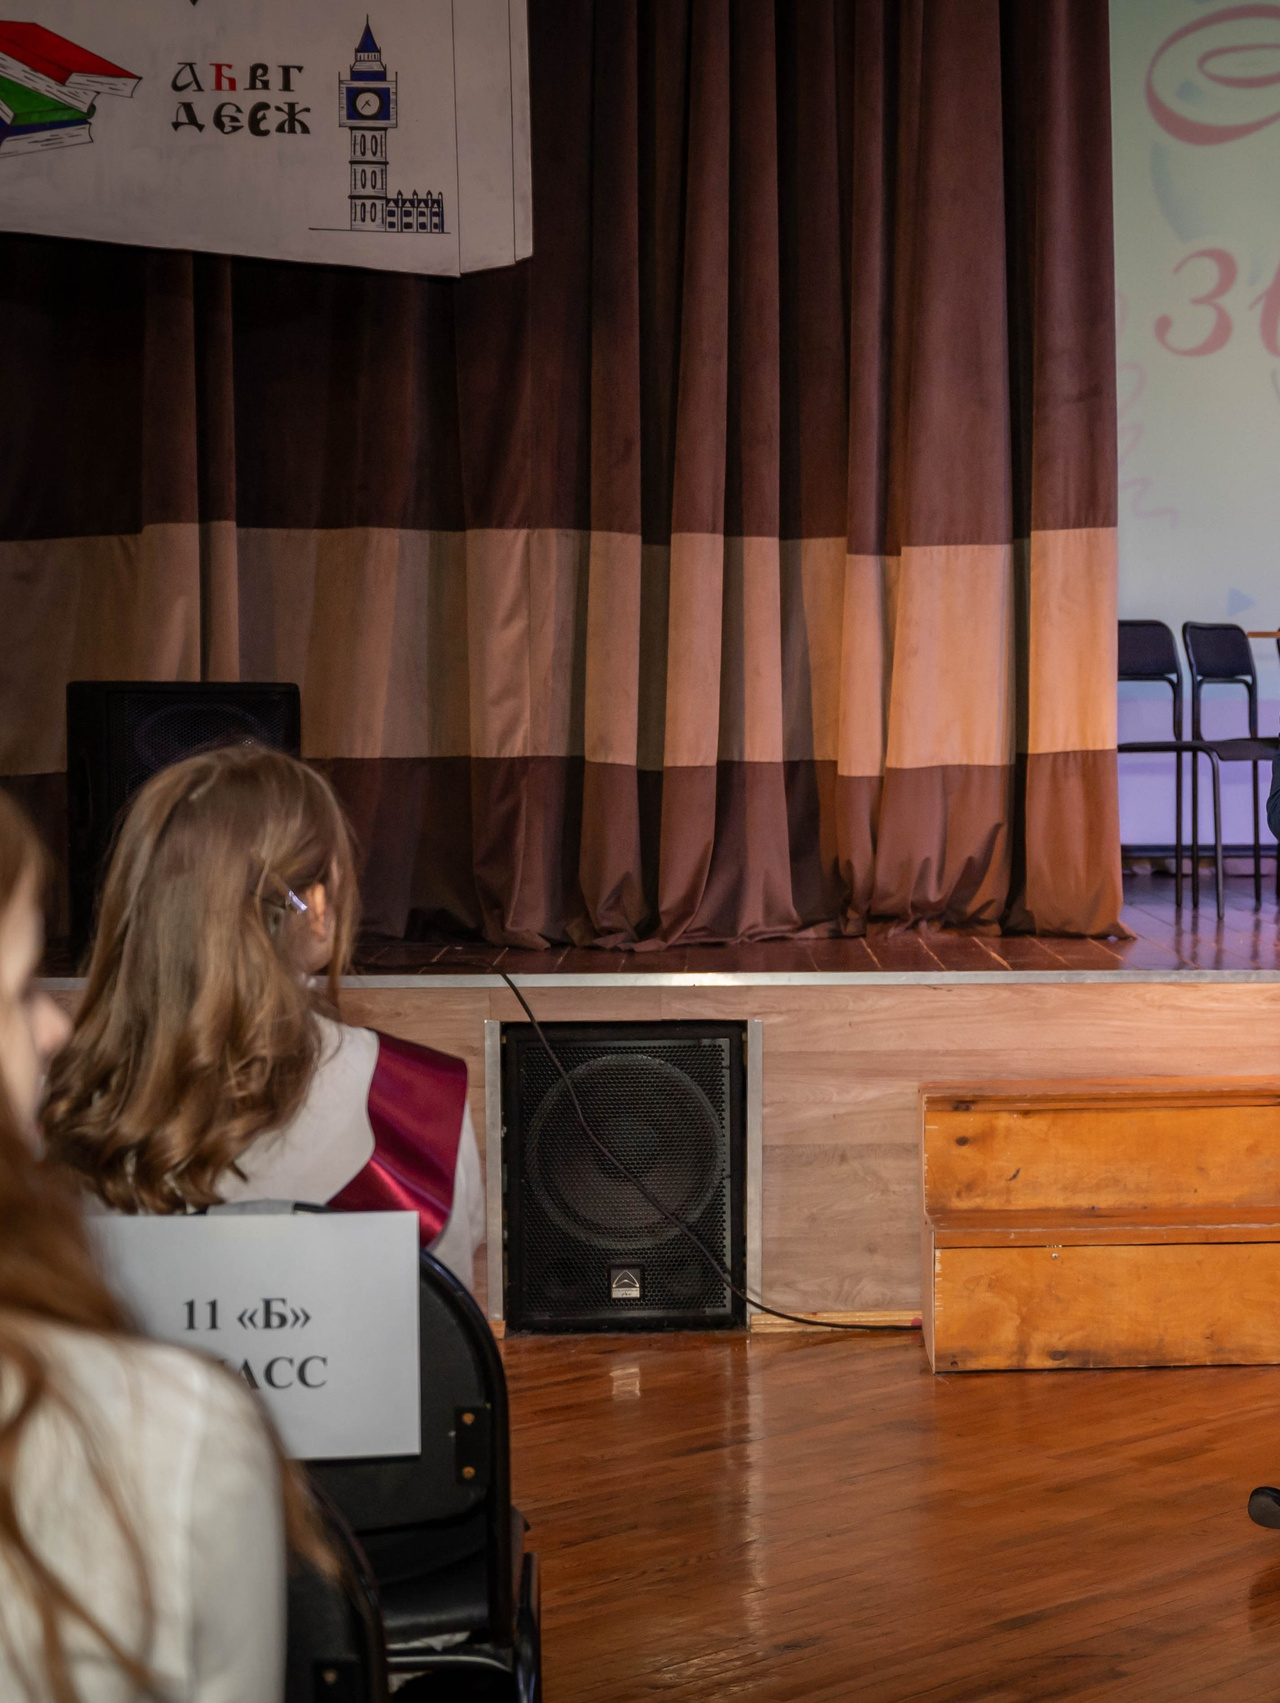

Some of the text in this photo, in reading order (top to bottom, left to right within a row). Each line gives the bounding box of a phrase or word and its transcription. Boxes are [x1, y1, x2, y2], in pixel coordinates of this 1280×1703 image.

[183, 1297, 312, 1331] 11 «Б»
[217, 1355, 329, 1390] АСС
